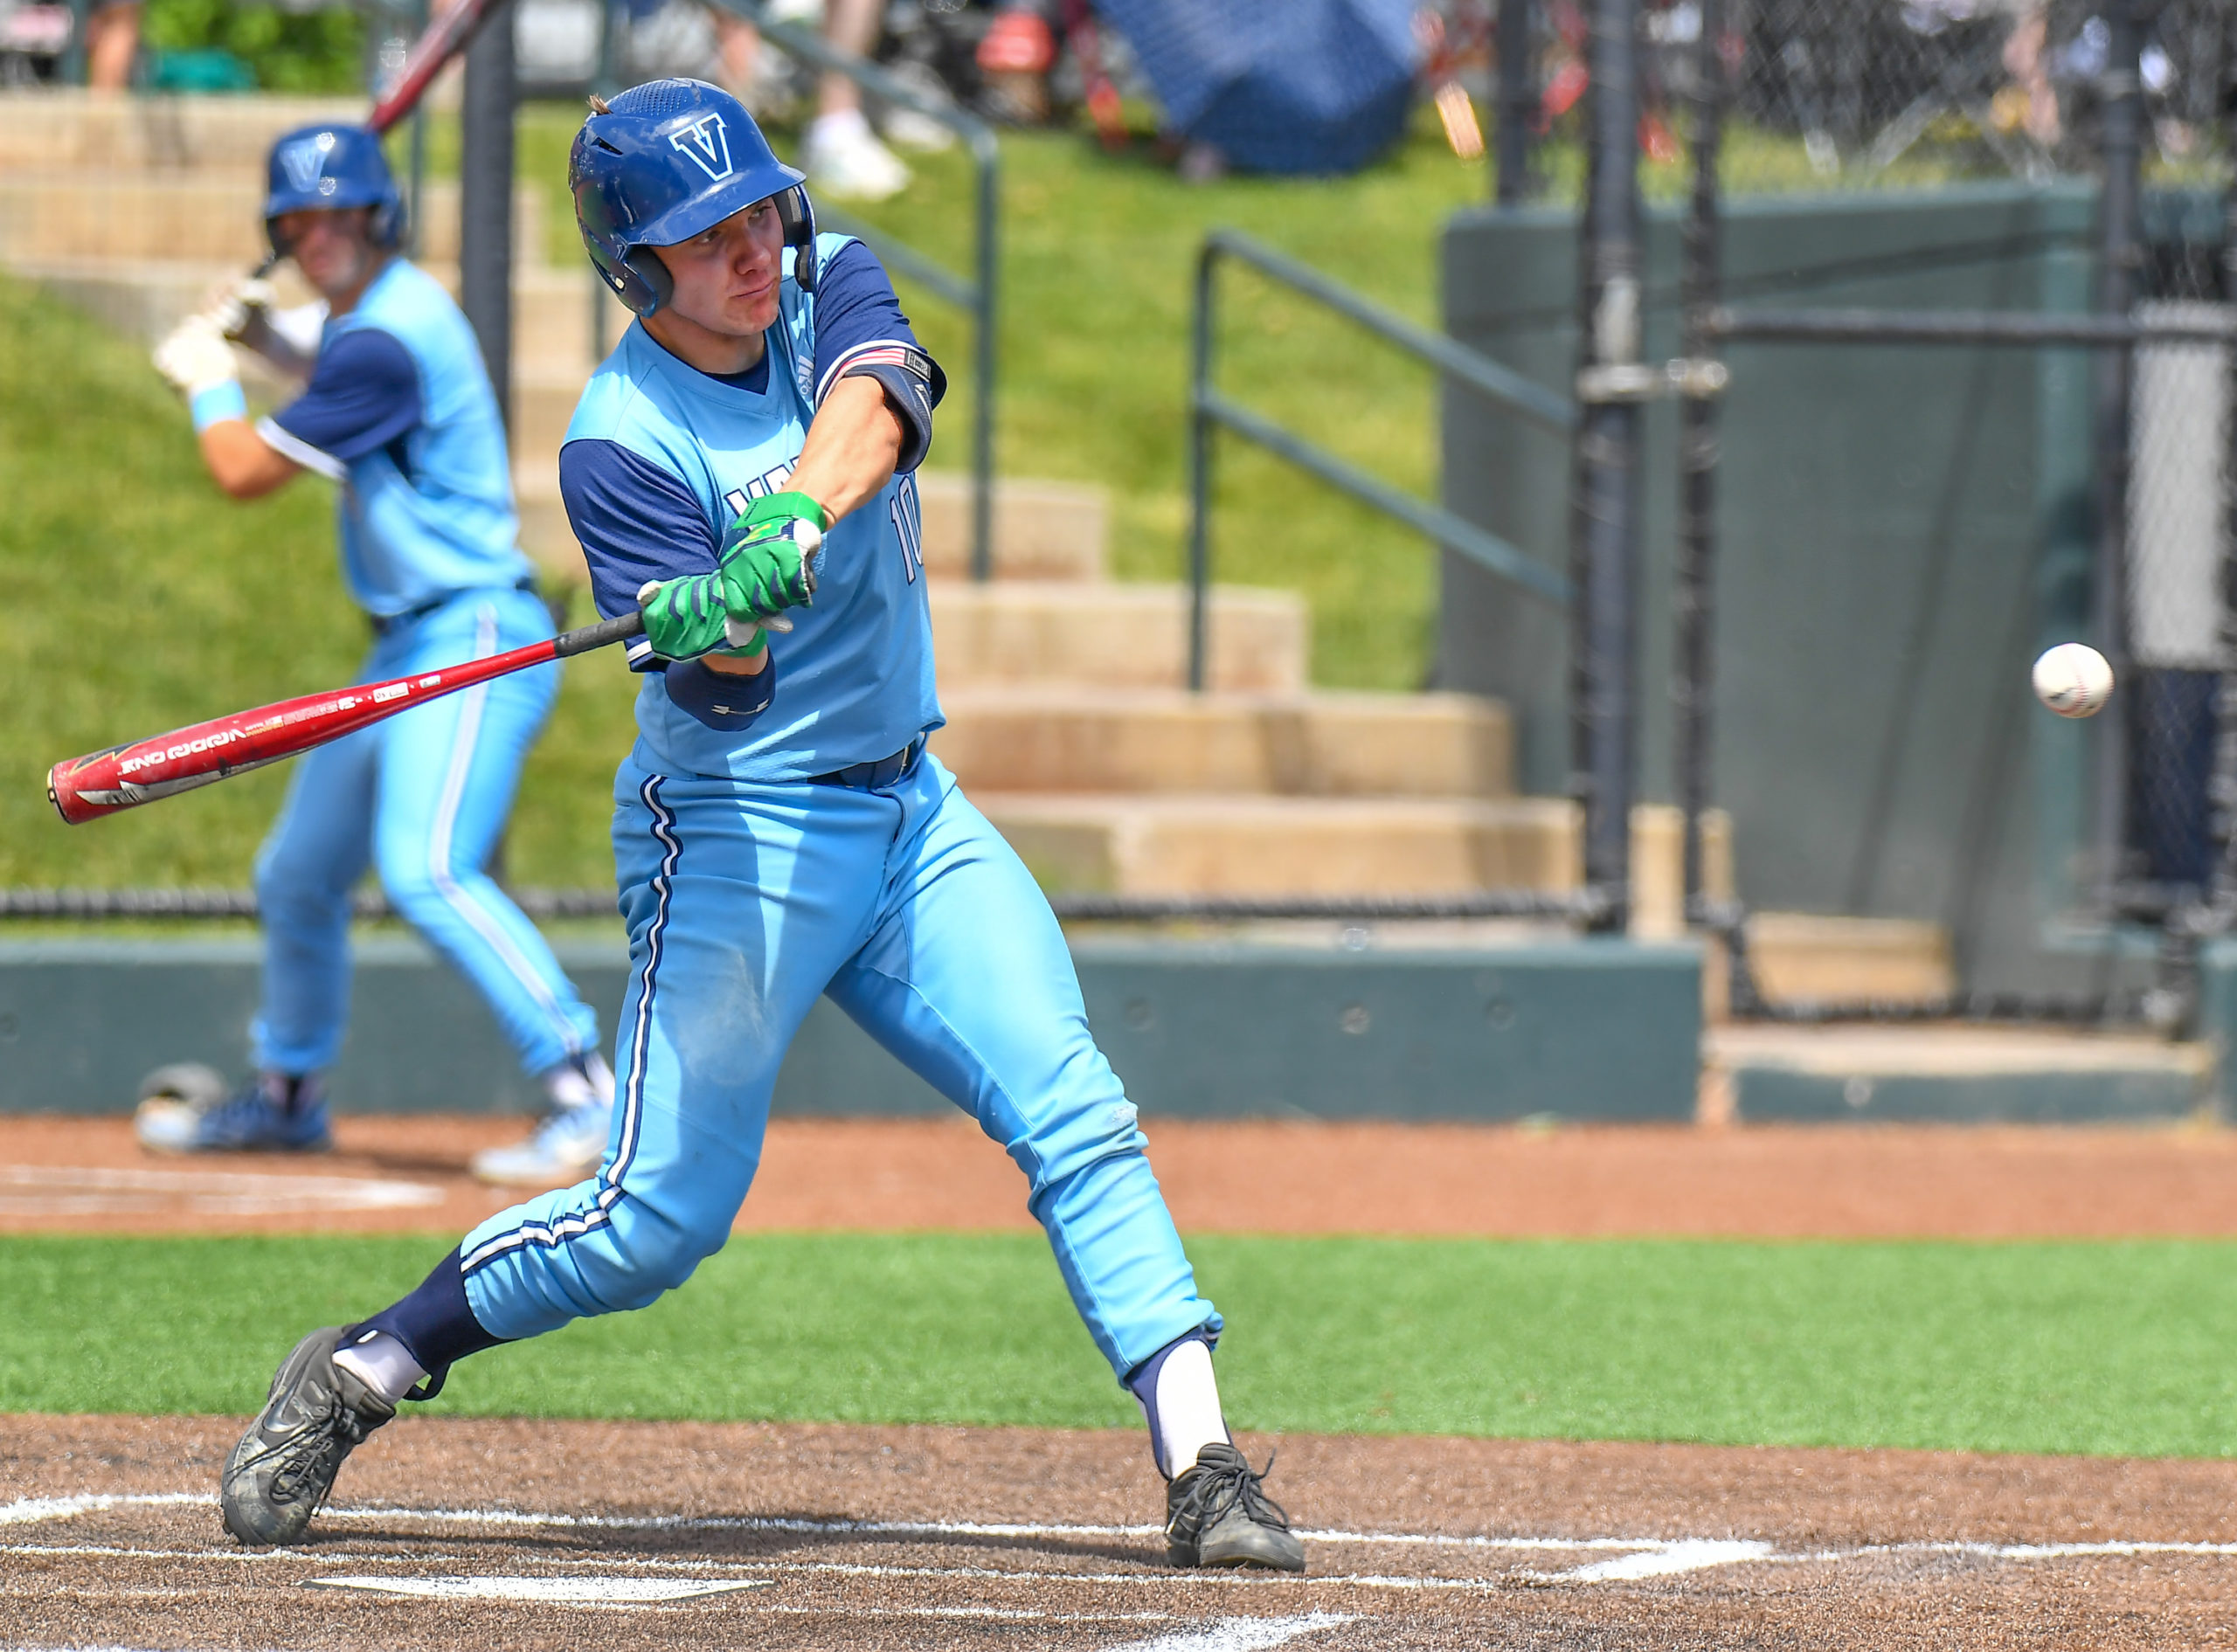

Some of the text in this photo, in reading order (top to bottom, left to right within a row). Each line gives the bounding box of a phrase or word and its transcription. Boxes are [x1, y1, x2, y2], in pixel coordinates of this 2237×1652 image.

[279, 134, 333, 192] V
[668, 112, 734, 182] V
[890, 474, 923, 585] 10
[121, 728, 247, 775] VOODOO ONE
